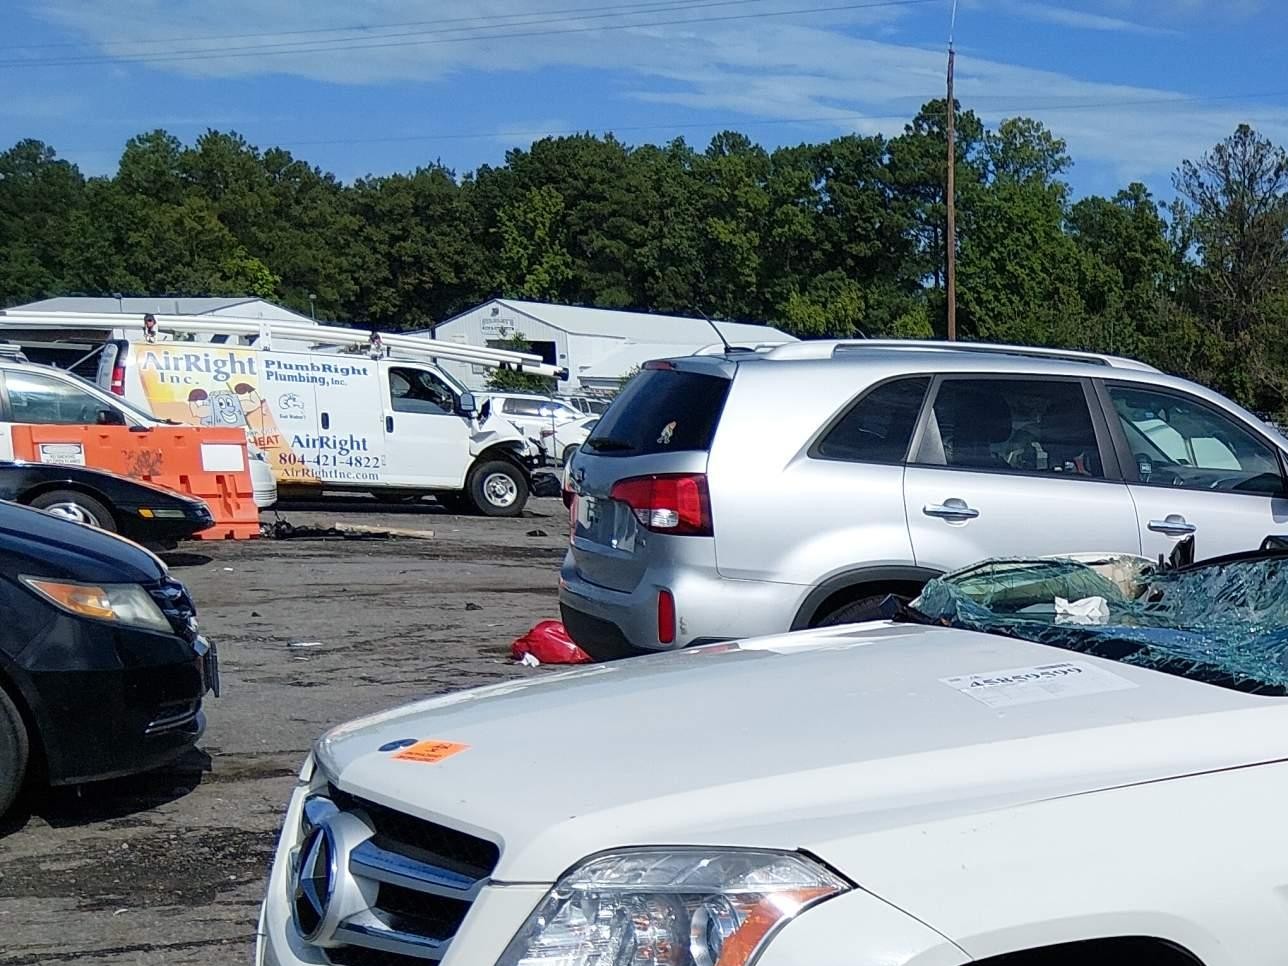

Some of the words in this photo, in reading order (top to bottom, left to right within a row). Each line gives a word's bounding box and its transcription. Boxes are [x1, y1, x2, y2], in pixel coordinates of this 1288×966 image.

[142, 351, 257, 382] AirRight
[264, 359, 369, 377] PlumbRight
[159, 372, 200, 385] Inc.
[266, 370, 330, 387] Plumbing,
[291, 433, 369, 456] AirRight
[279, 453, 380, 469] 804-421-4822
[281, 467, 380, 481] AirRightInc.com
